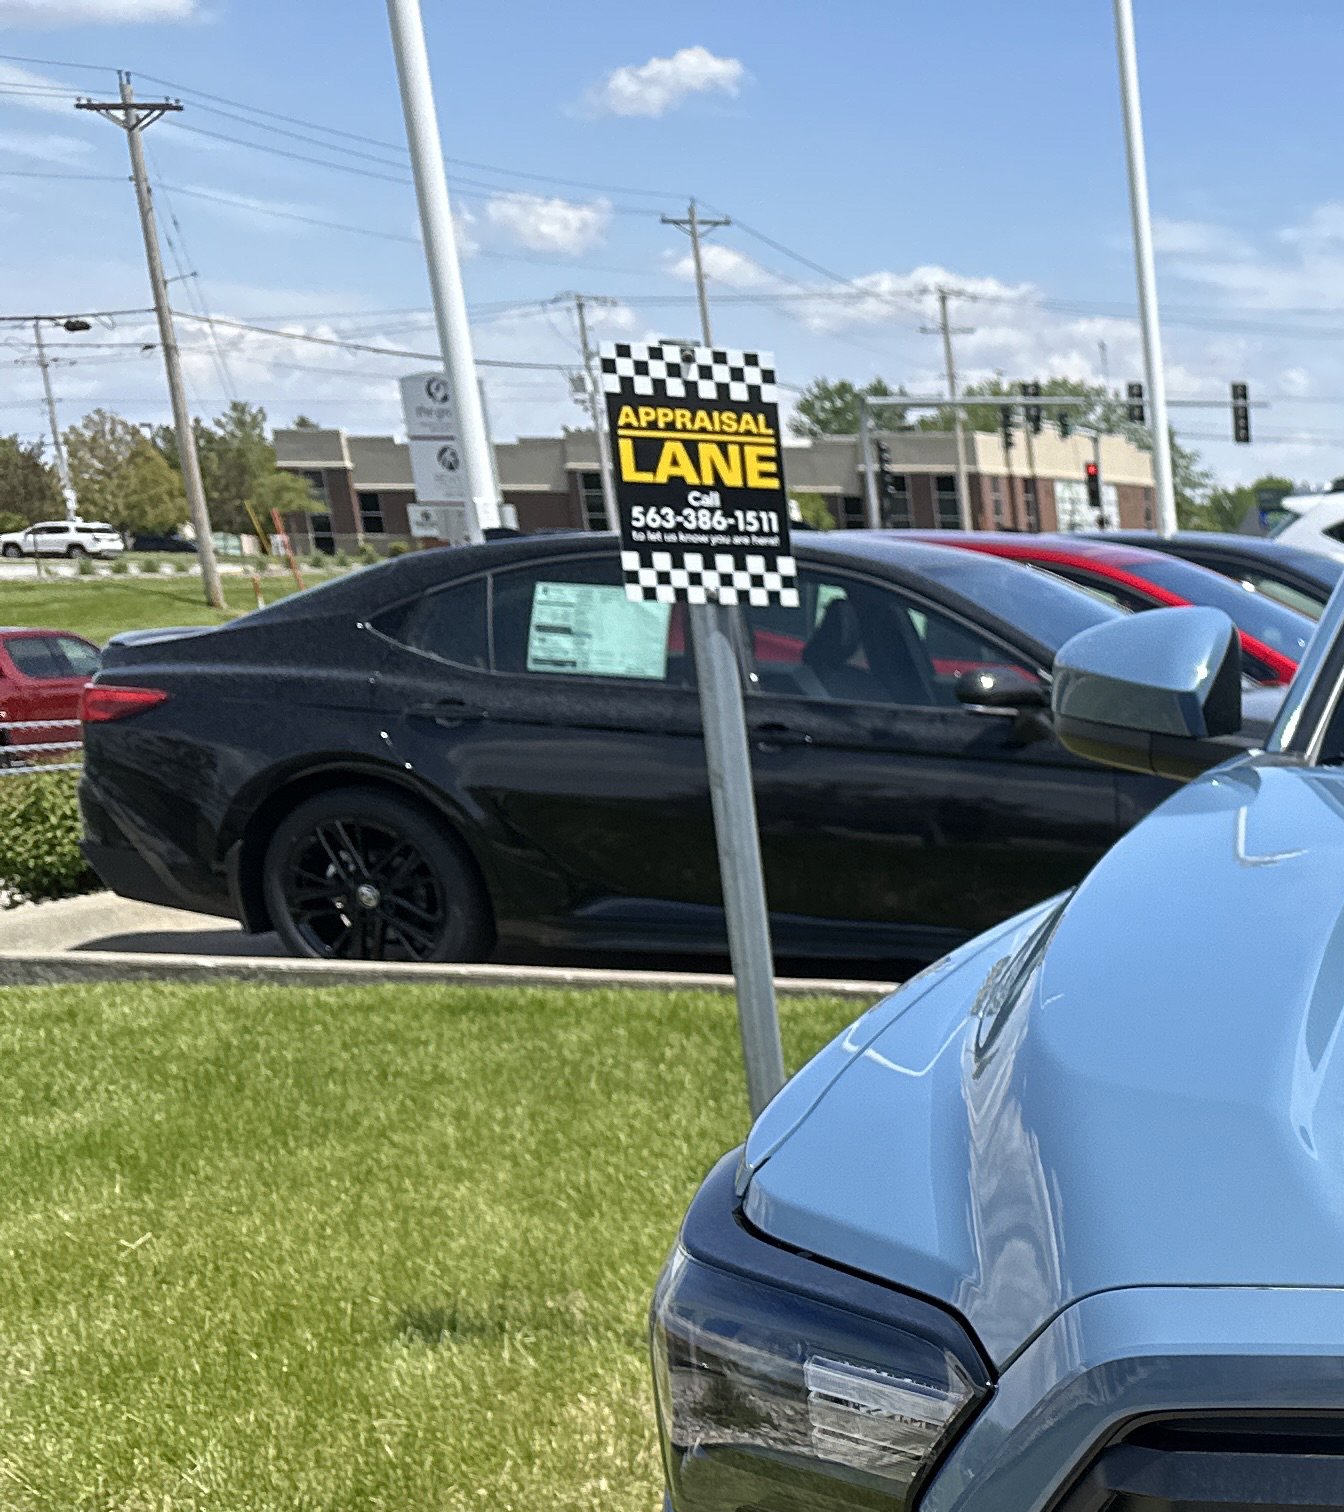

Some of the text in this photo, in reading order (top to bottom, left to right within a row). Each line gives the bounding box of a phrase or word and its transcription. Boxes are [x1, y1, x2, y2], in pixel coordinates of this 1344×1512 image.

[617, 405, 774, 435] APPRAISAL
[618, 437, 780, 490] LANE
[687, 490, 721, 508] Call
[631, 505, 780, 533] 563-386-1511
